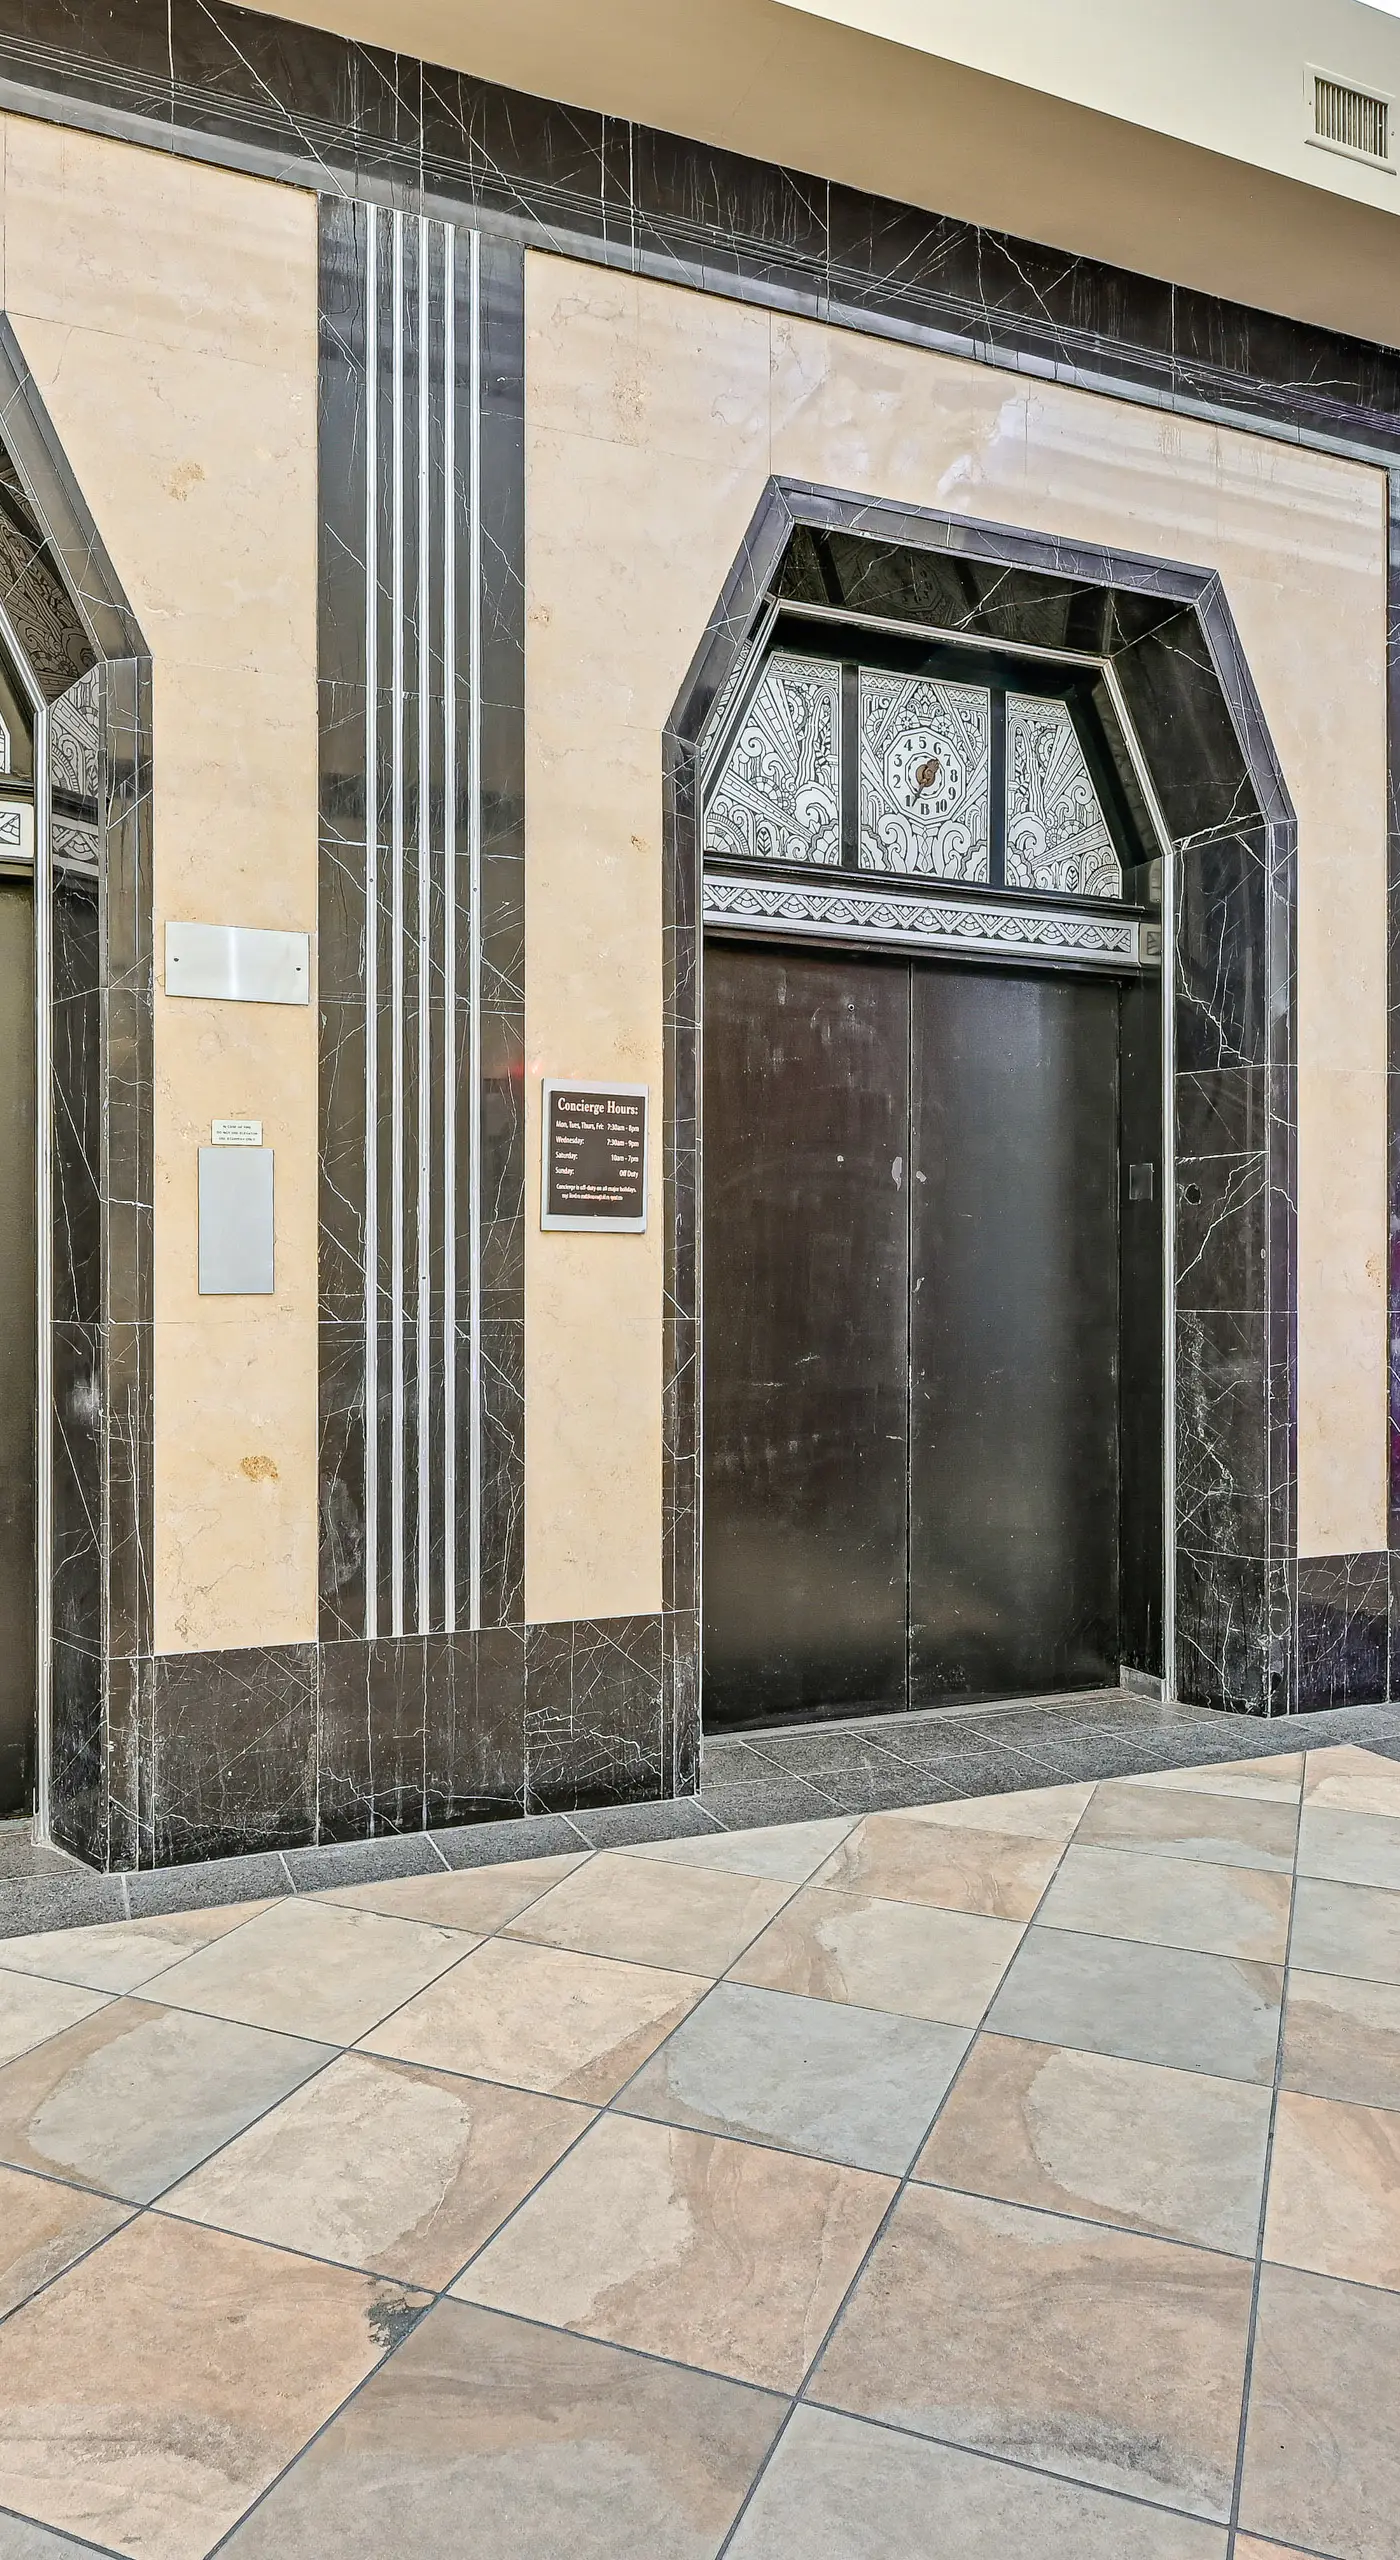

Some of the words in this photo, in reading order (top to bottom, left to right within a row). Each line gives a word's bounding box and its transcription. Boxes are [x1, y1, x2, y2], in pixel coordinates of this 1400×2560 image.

[904, 739, 913, 751] 4
[919, 737, 927, 749] 5
[934, 742, 942, 755] 6
[894, 754, 902, 767] 3
[944, 754, 951, 766] 7
[893, 775, 901, 788] 2
[950, 769, 958, 782] 8
[948, 787, 956, 800] 9
[905, 795, 910, 807] 1
[936, 799, 947, 813] 10
[921, 803, 930, 815] B
[558, 1097, 605, 1115] Concierge
[607, 1100, 639, 1115] Hours:
[607, 1123, 625, 1131] 7:30am
[556, 1136, 585, 1146] Wednesday:
[607, 1138, 625, 1147] 7:30am
[555, 1151, 578, 1161] Saturday:
[611, 1154, 624, 1162] 10am
[628, 1155, 639, 1164] 7pm
[555, 1167, 575, 1176] Sunday:
[627, 1171, 639, 1179] Duty
